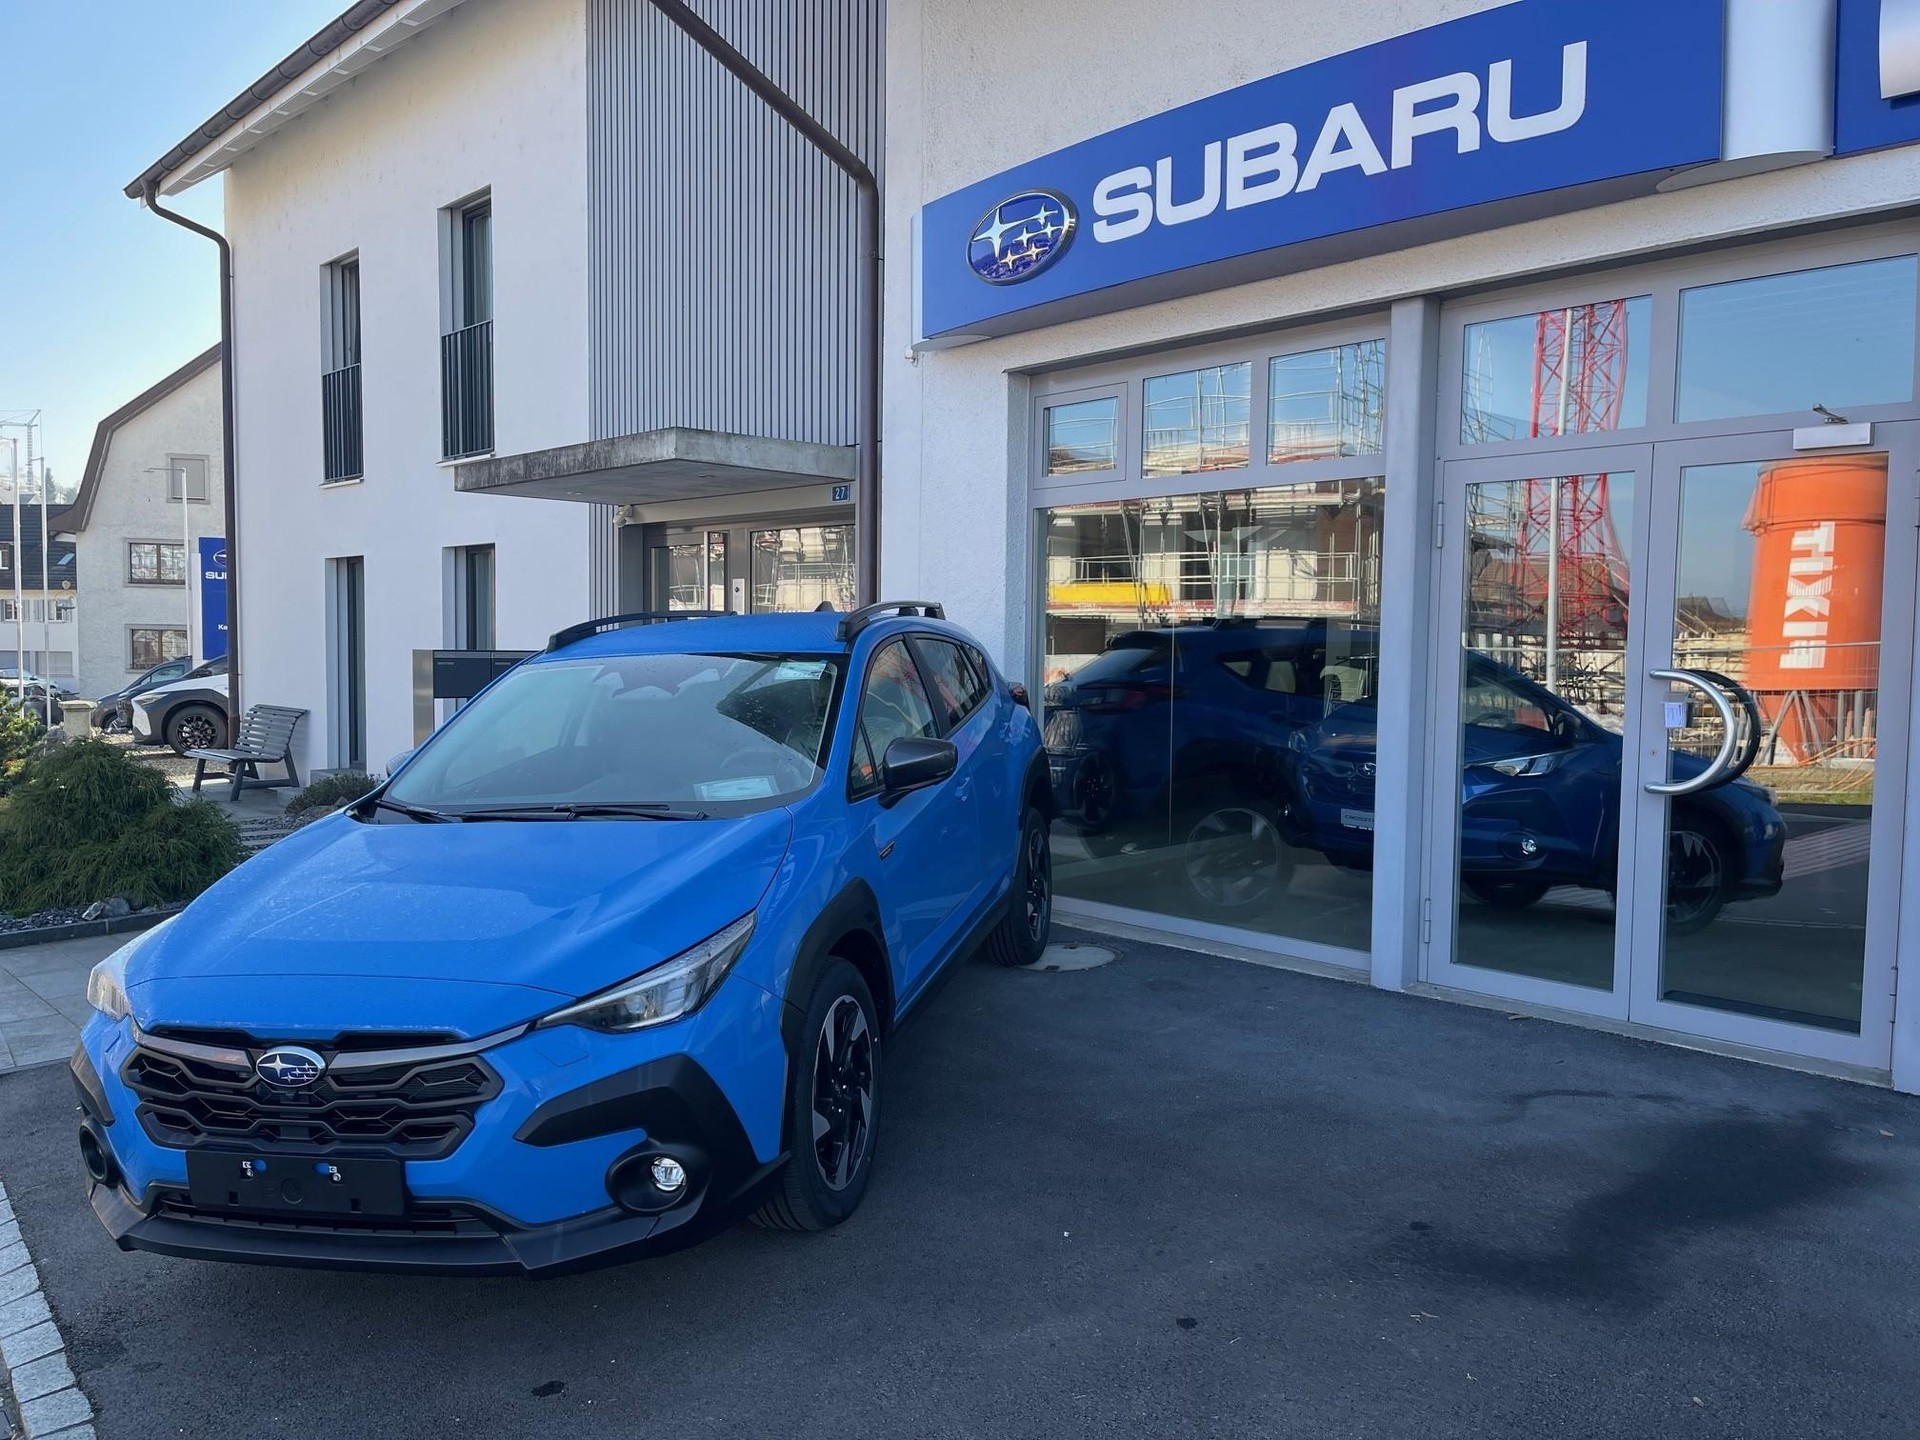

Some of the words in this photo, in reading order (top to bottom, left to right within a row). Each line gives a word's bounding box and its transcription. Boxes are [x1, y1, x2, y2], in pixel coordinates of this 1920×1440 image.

[1092, 41, 1588, 244] SUBARU
[834, 487, 846, 501] 27
[205, 571, 227, 580] SU
